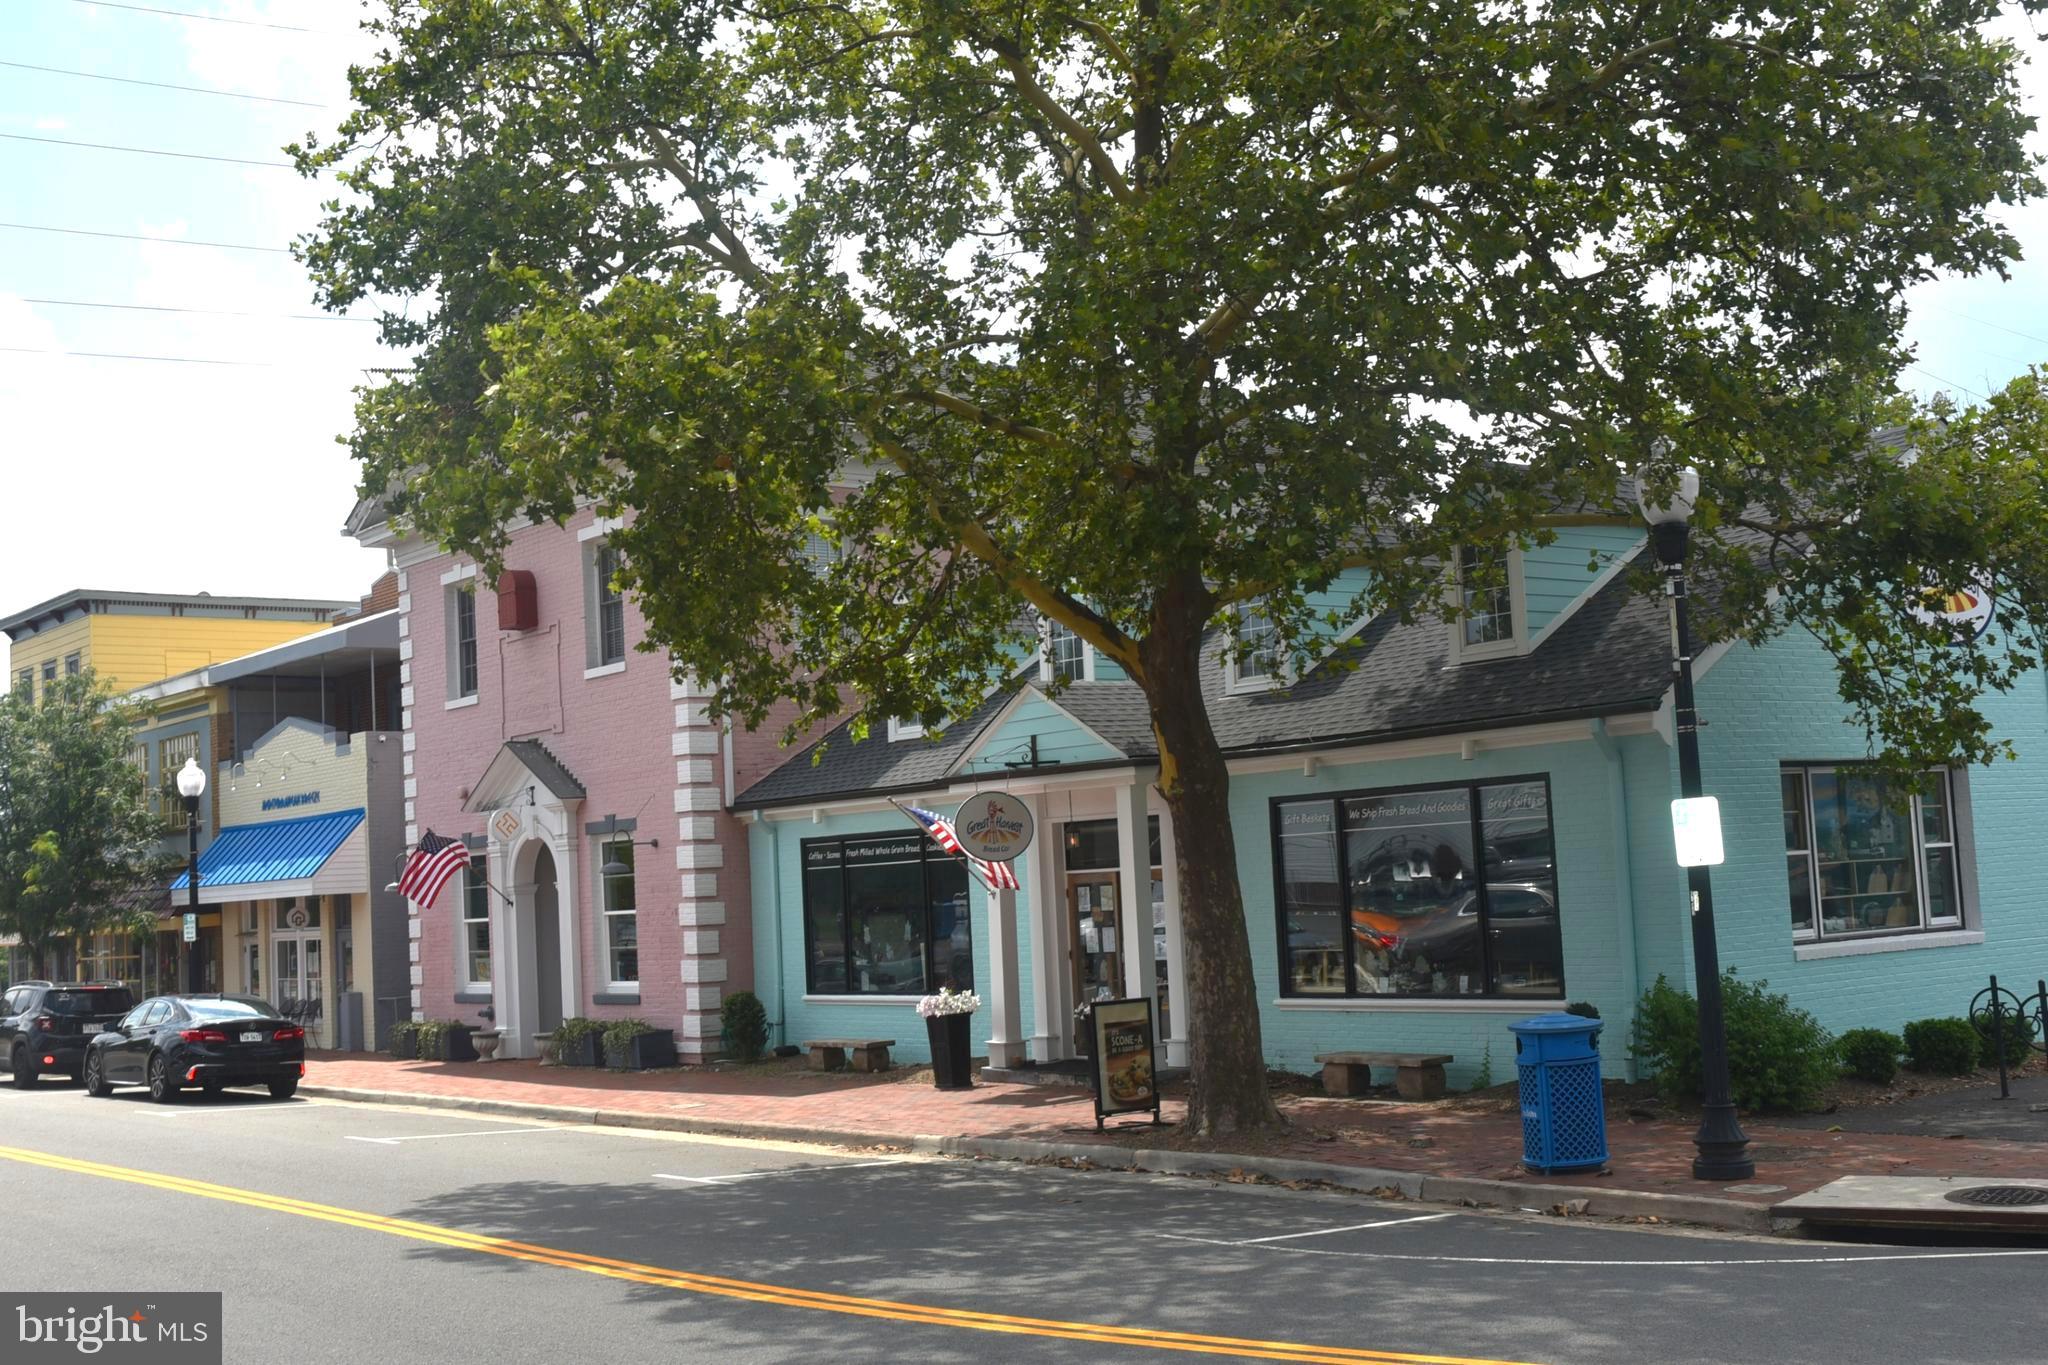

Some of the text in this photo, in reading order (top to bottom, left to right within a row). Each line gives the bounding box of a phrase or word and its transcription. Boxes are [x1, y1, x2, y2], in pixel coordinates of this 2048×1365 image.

[1361, 808, 1377, 820] Ship
[1378, 806, 1398, 817] Fresh
[1399, 804, 1420, 816] Bread
[1421, 802, 1436, 814] And
[1437, 801, 1466, 813] Goodies
[967, 817, 990, 835] Great
